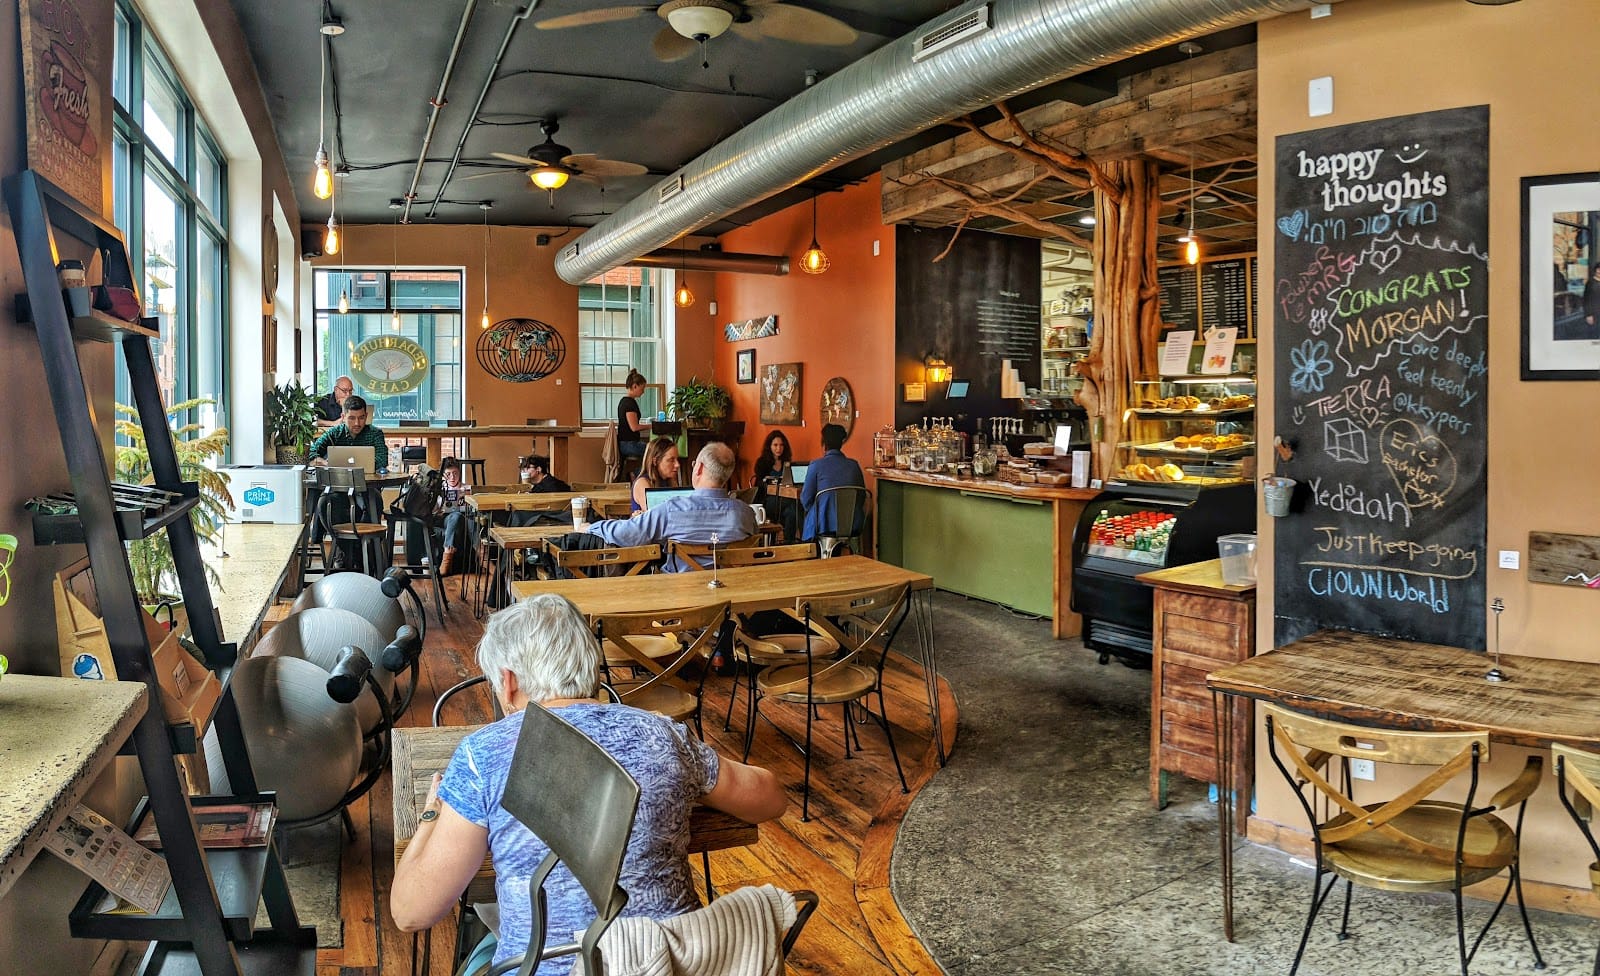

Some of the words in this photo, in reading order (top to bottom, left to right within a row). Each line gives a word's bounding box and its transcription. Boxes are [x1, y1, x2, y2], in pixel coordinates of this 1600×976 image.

[50, 64, 89, 120] Fresh
[1297, 149, 1384, 181] happy
[1321, 171, 1448, 214] thoughts
[1337, 266, 1471, 317] CONGRATS
[1397, 358, 1425, 387] Feel
[1400, 338, 1439, 360] Love
[1445, 339, 1488, 378] deeply
